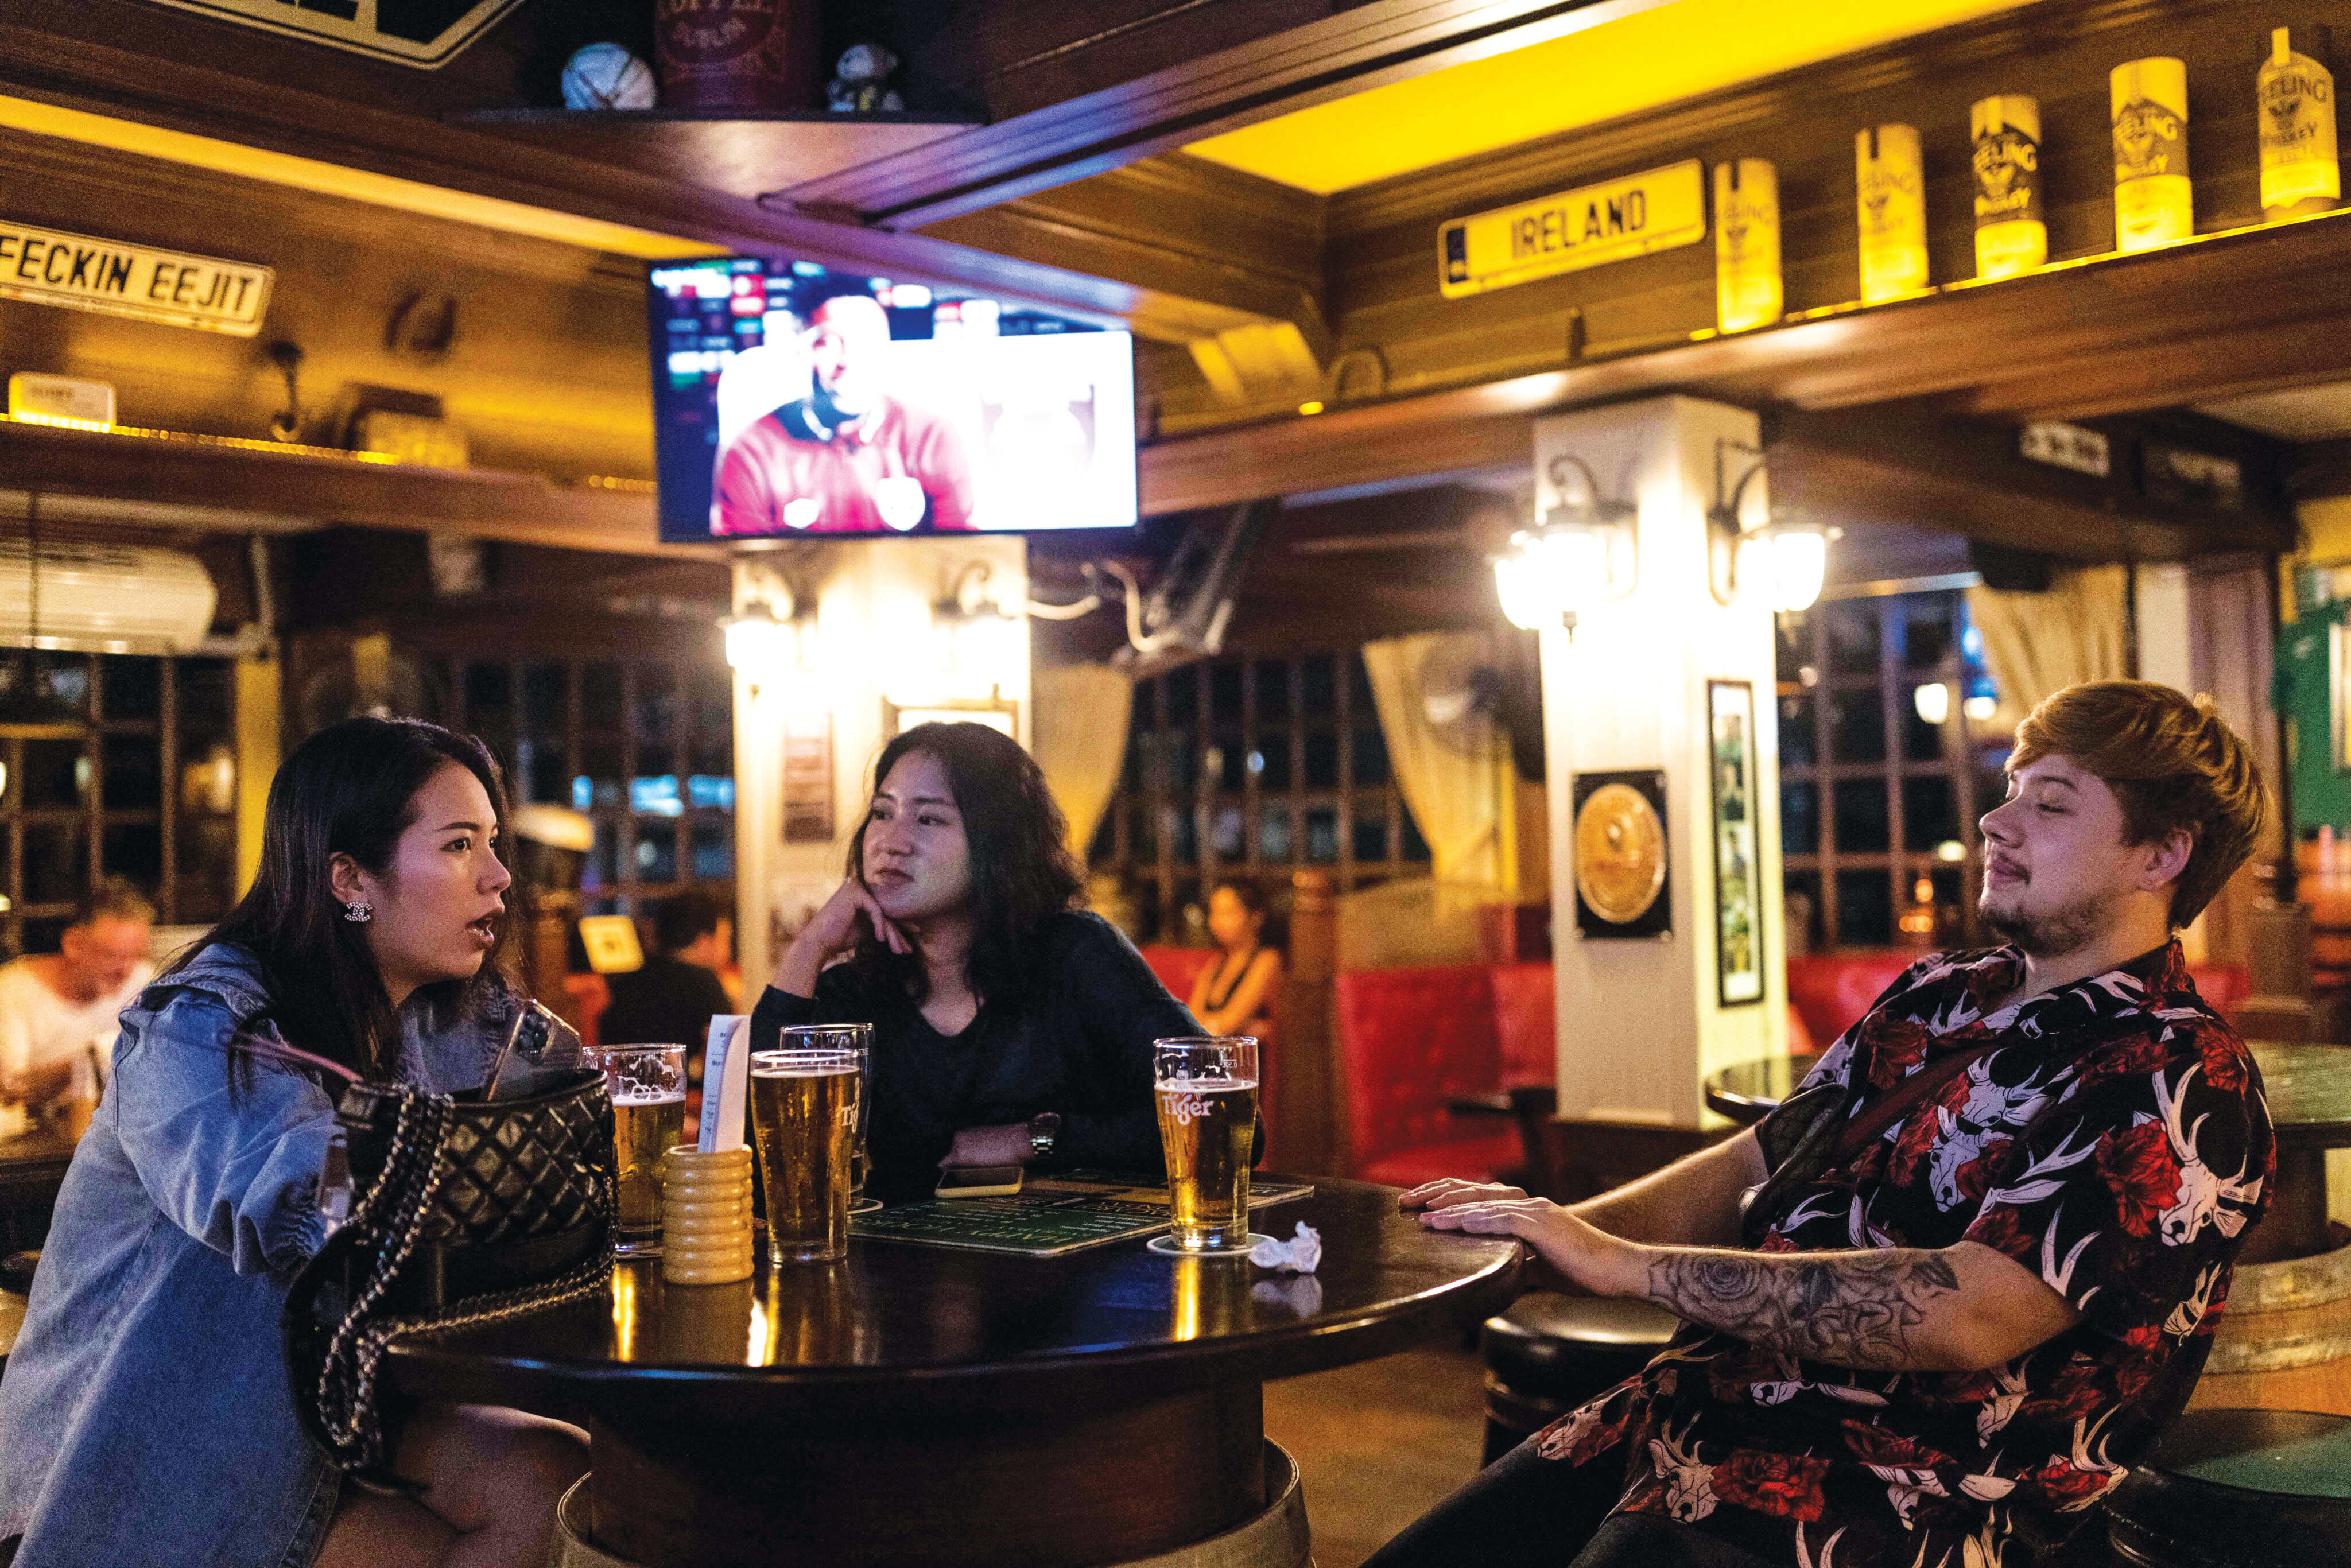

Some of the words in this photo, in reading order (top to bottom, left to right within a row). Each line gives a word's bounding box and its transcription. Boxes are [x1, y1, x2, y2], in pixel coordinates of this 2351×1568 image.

[2261, 75, 2327, 103] EELING
[1511, 189, 1646, 259] IRELAND
[0, 235, 134, 295] FECKIN
[148, 262, 254, 311] EEJIT
[841, 1102, 859, 1134] Tig
[1161, 1092, 1214, 1125] Tiger
